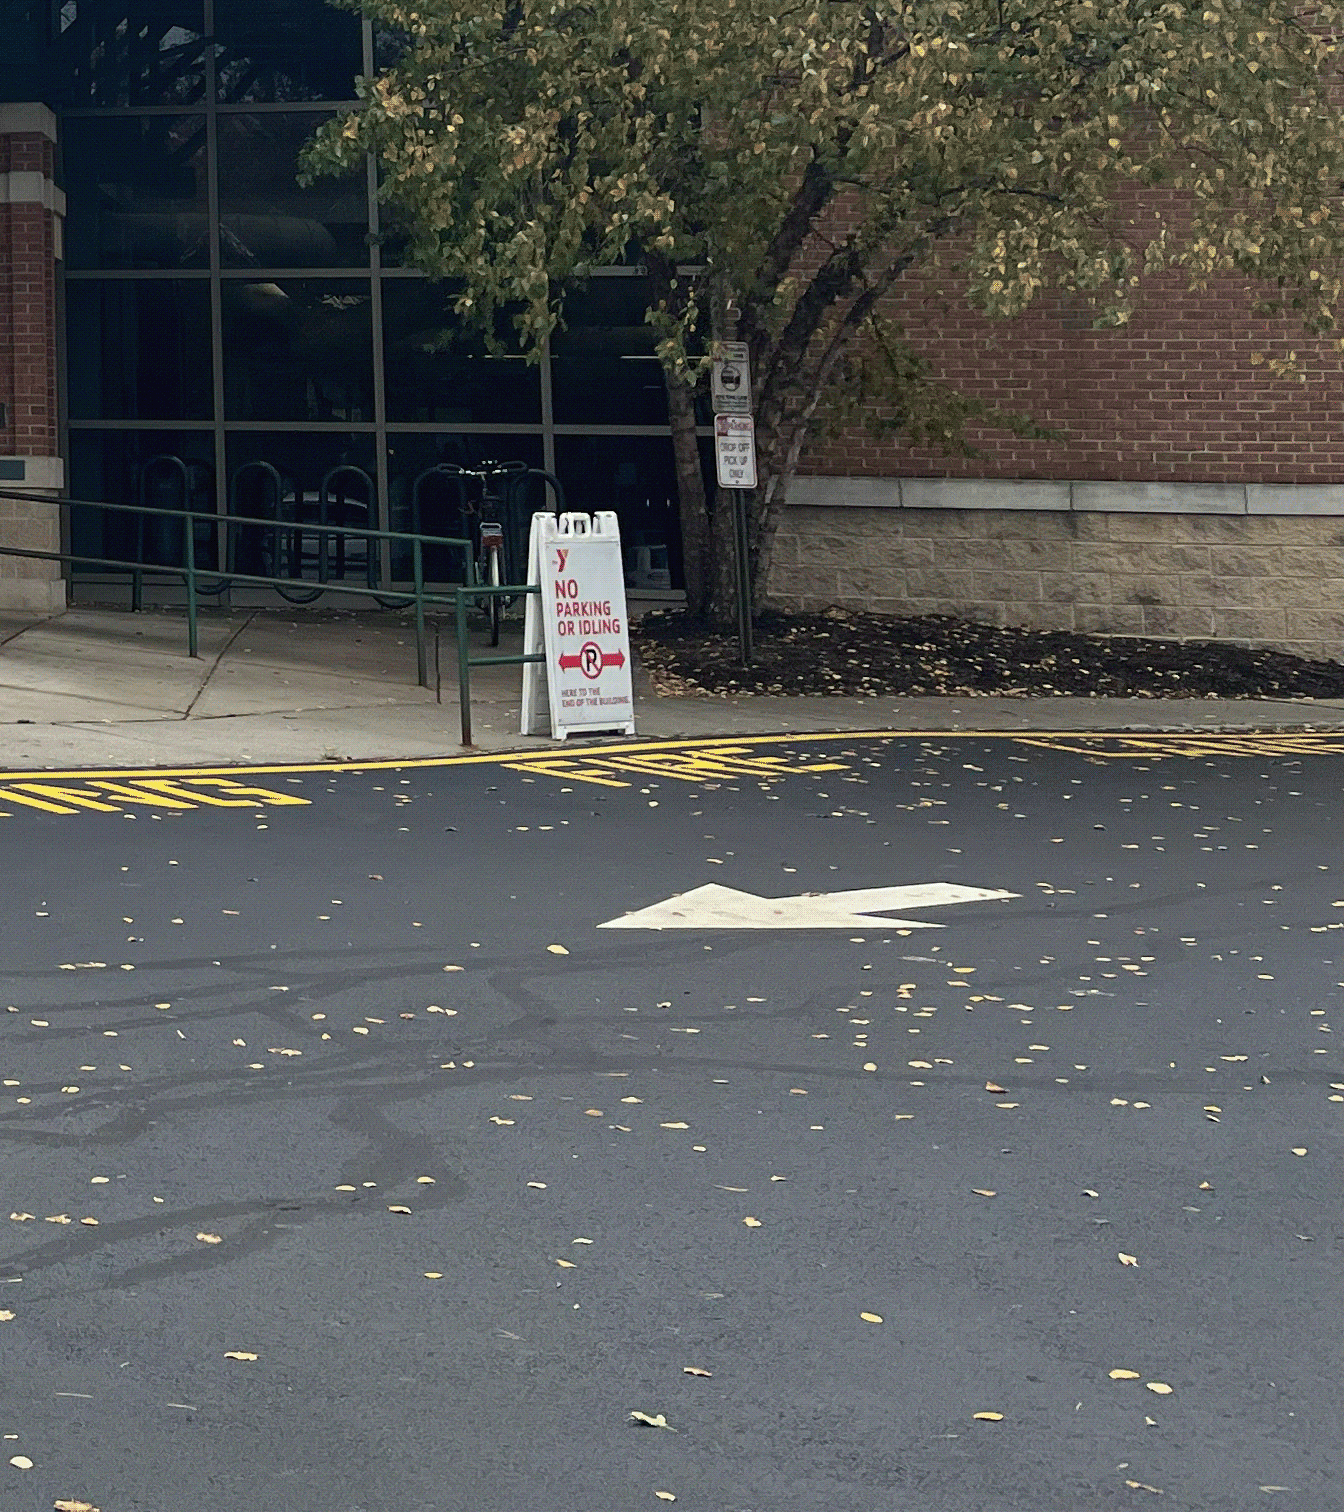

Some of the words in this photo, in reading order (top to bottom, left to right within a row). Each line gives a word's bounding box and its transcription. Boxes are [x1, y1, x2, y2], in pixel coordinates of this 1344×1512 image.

[738, 442, 750, 453] OFF
[555, 579, 578, 599] NO
[556, 600, 611, 617] PARKING
[558, 619, 575, 636] OR
[579, 618, 621, 636] IDLING
[561, 688, 577, 698] HERE
[588, 687, 600, 696] THE
[562, 699, 575, 707] END
[586, 697, 598, 706] THE
[499, 746, 851, 787] FIRE
